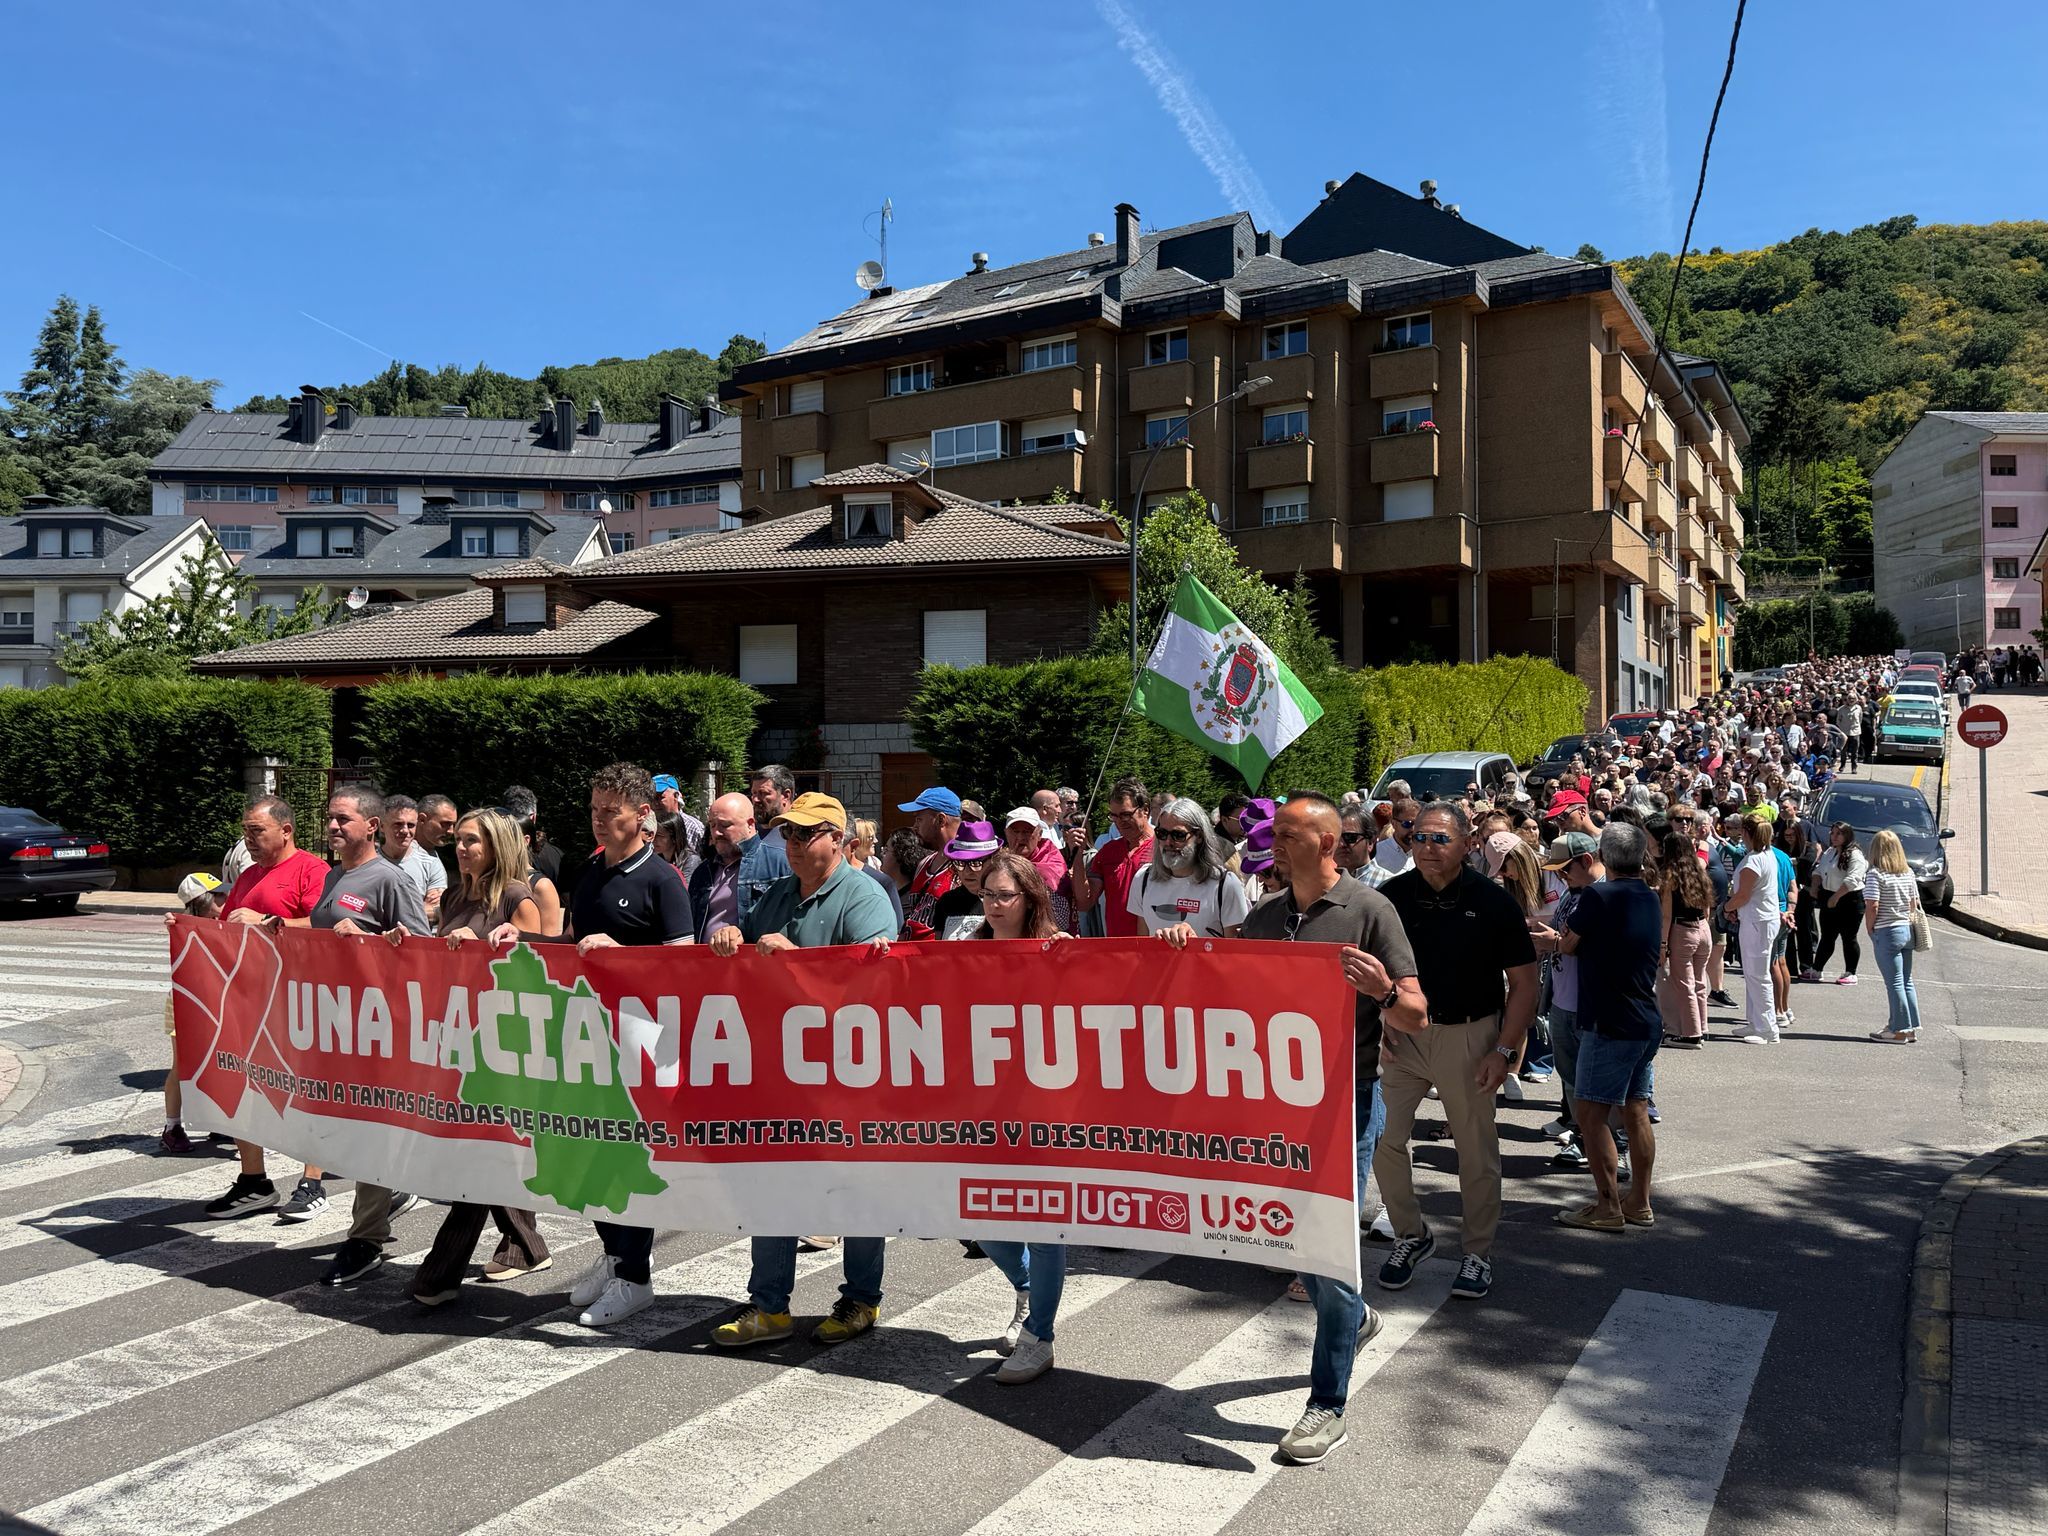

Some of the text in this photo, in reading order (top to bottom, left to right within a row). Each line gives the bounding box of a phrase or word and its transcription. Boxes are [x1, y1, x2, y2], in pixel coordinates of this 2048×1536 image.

[342, 894, 366, 907] CCOO
[1178, 899, 1199, 907] CCOO
[287, 980, 1325, 1107] UNA LACIANA CON FUTURO
[216, 1050, 241, 1073] HAY
[258, 1065, 298, 1095] PONER
[298, 1076, 329, 1101] FIN
[333, 1082, 346, 1103] A
[348, 1084, 415, 1114] TANTAS
[417, 1092, 506, 1126] DÉCADAS
[508, 1106, 535, 1132] DE
[539, 1110, 678, 1148] PROMESAS,
[684, 1119, 854, 1148] MENTIRAS,
[860, 1120, 996, 1146] EXCUSAS
[1002, 1121, 1023, 1147] Y
[1029, 1122, 1312, 1173] DISCRIMINACIÓN
[967, 1187, 1065, 1215] CCOO
[1081, 1188, 1153, 1225] UGT
[1200, 1193, 1295, 1237] USO
[1203, 1231, 1295, 1251] UNIÓN SINDICAL OBRERA
